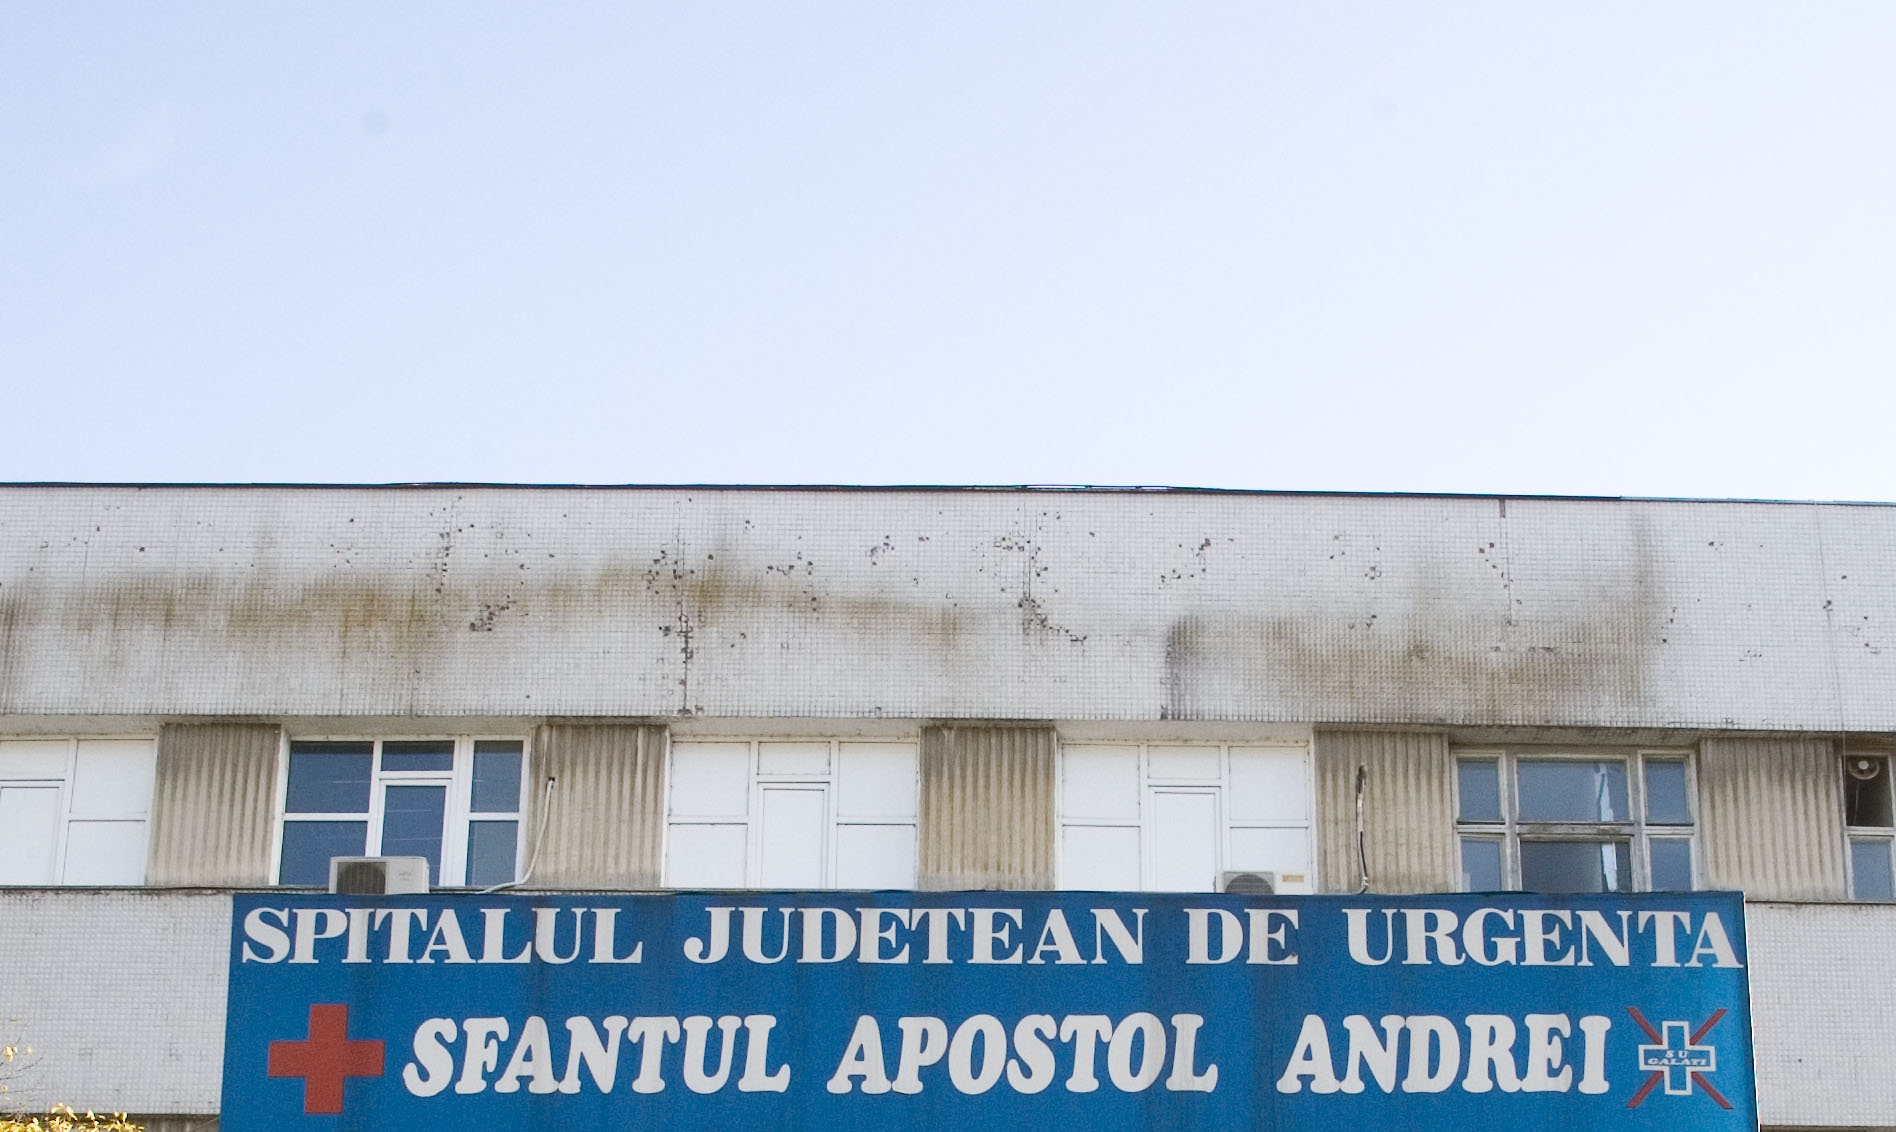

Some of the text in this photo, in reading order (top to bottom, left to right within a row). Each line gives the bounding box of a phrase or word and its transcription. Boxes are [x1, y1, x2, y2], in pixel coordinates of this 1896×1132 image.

[242, 907, 1745, 968] SPITALUL JUDETEAN DE URGENTA
[403, 1013, 1611, 1097] SFANTUL APOSTOL ANDREI
[1647, 1058, 1708, 1066] GALATI
